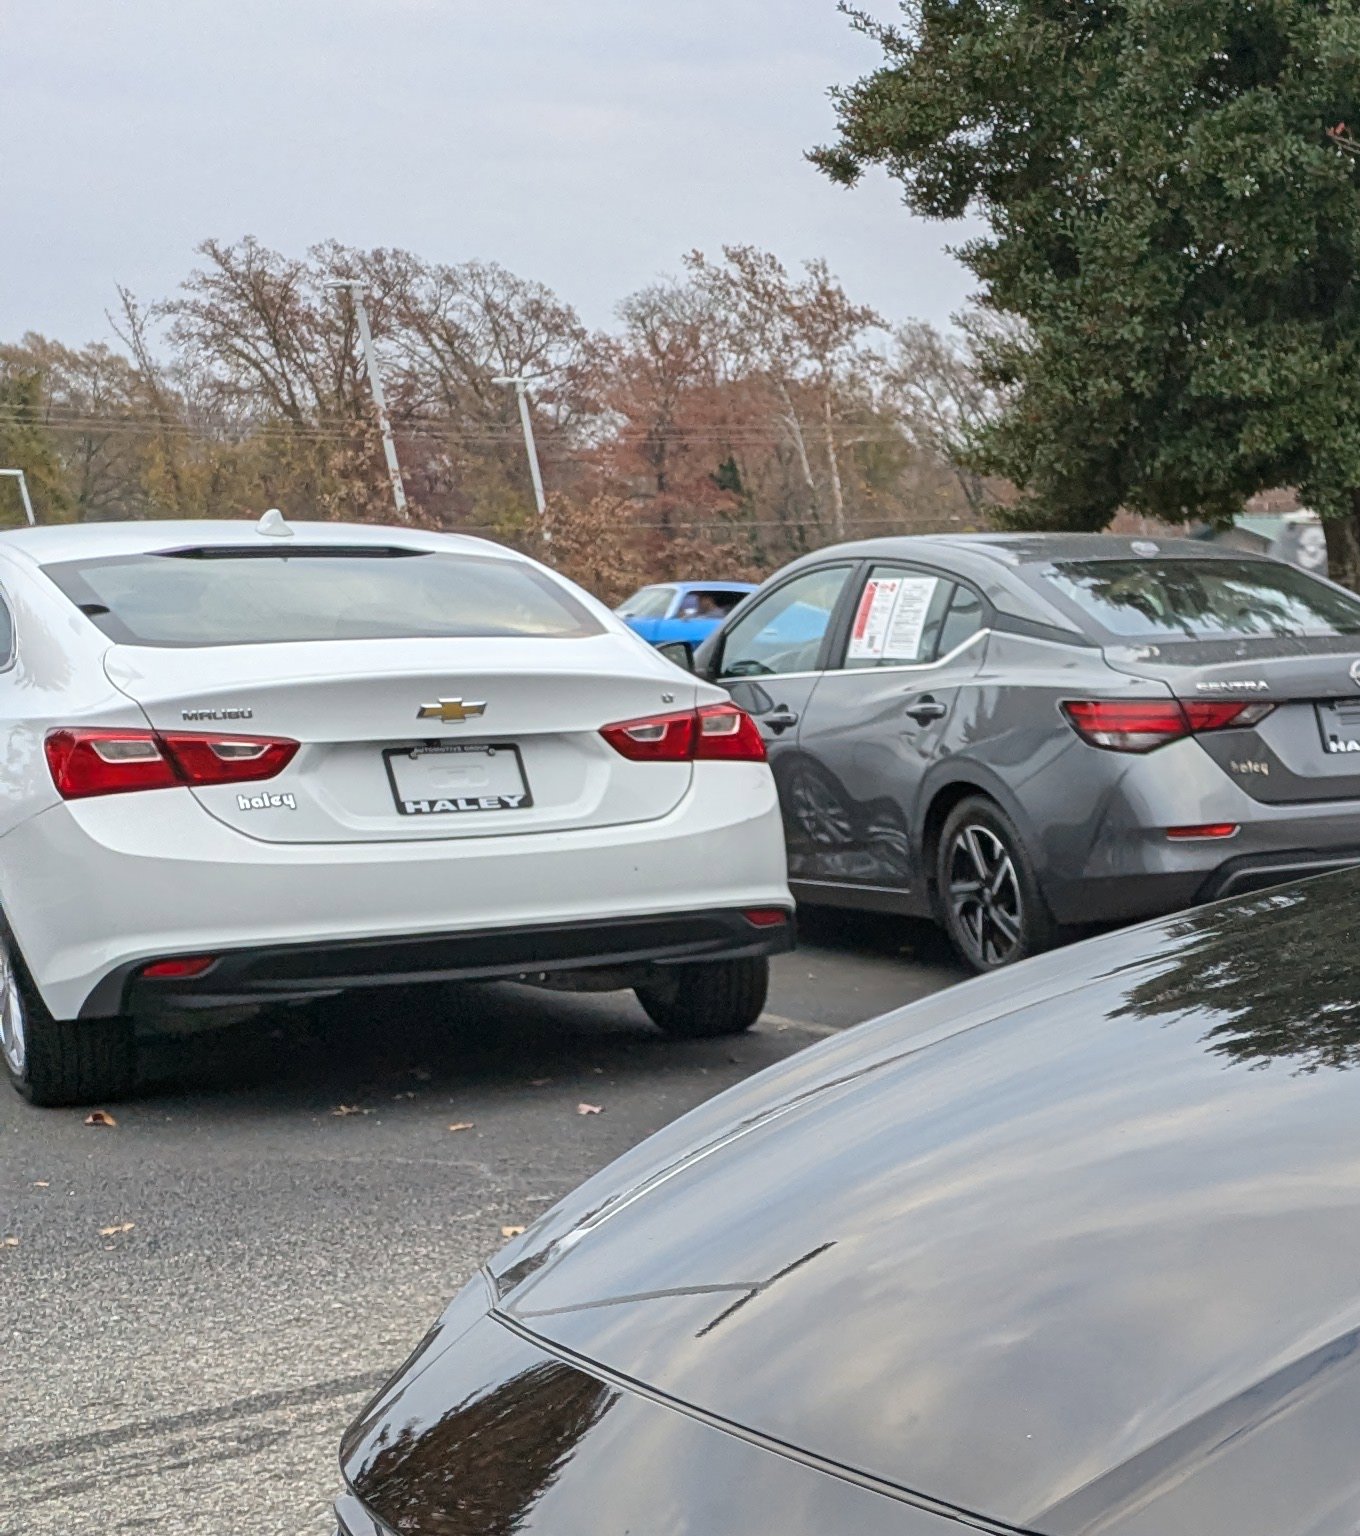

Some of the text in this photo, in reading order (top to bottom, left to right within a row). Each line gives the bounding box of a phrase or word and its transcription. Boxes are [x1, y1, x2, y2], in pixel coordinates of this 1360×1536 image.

[1195, 680, 1270, 692] SENTRA
[181, 708, 254, 721] MALIBU
[237, 791, 297, 811] haley
[404, 795, 526, 814] HALEY
